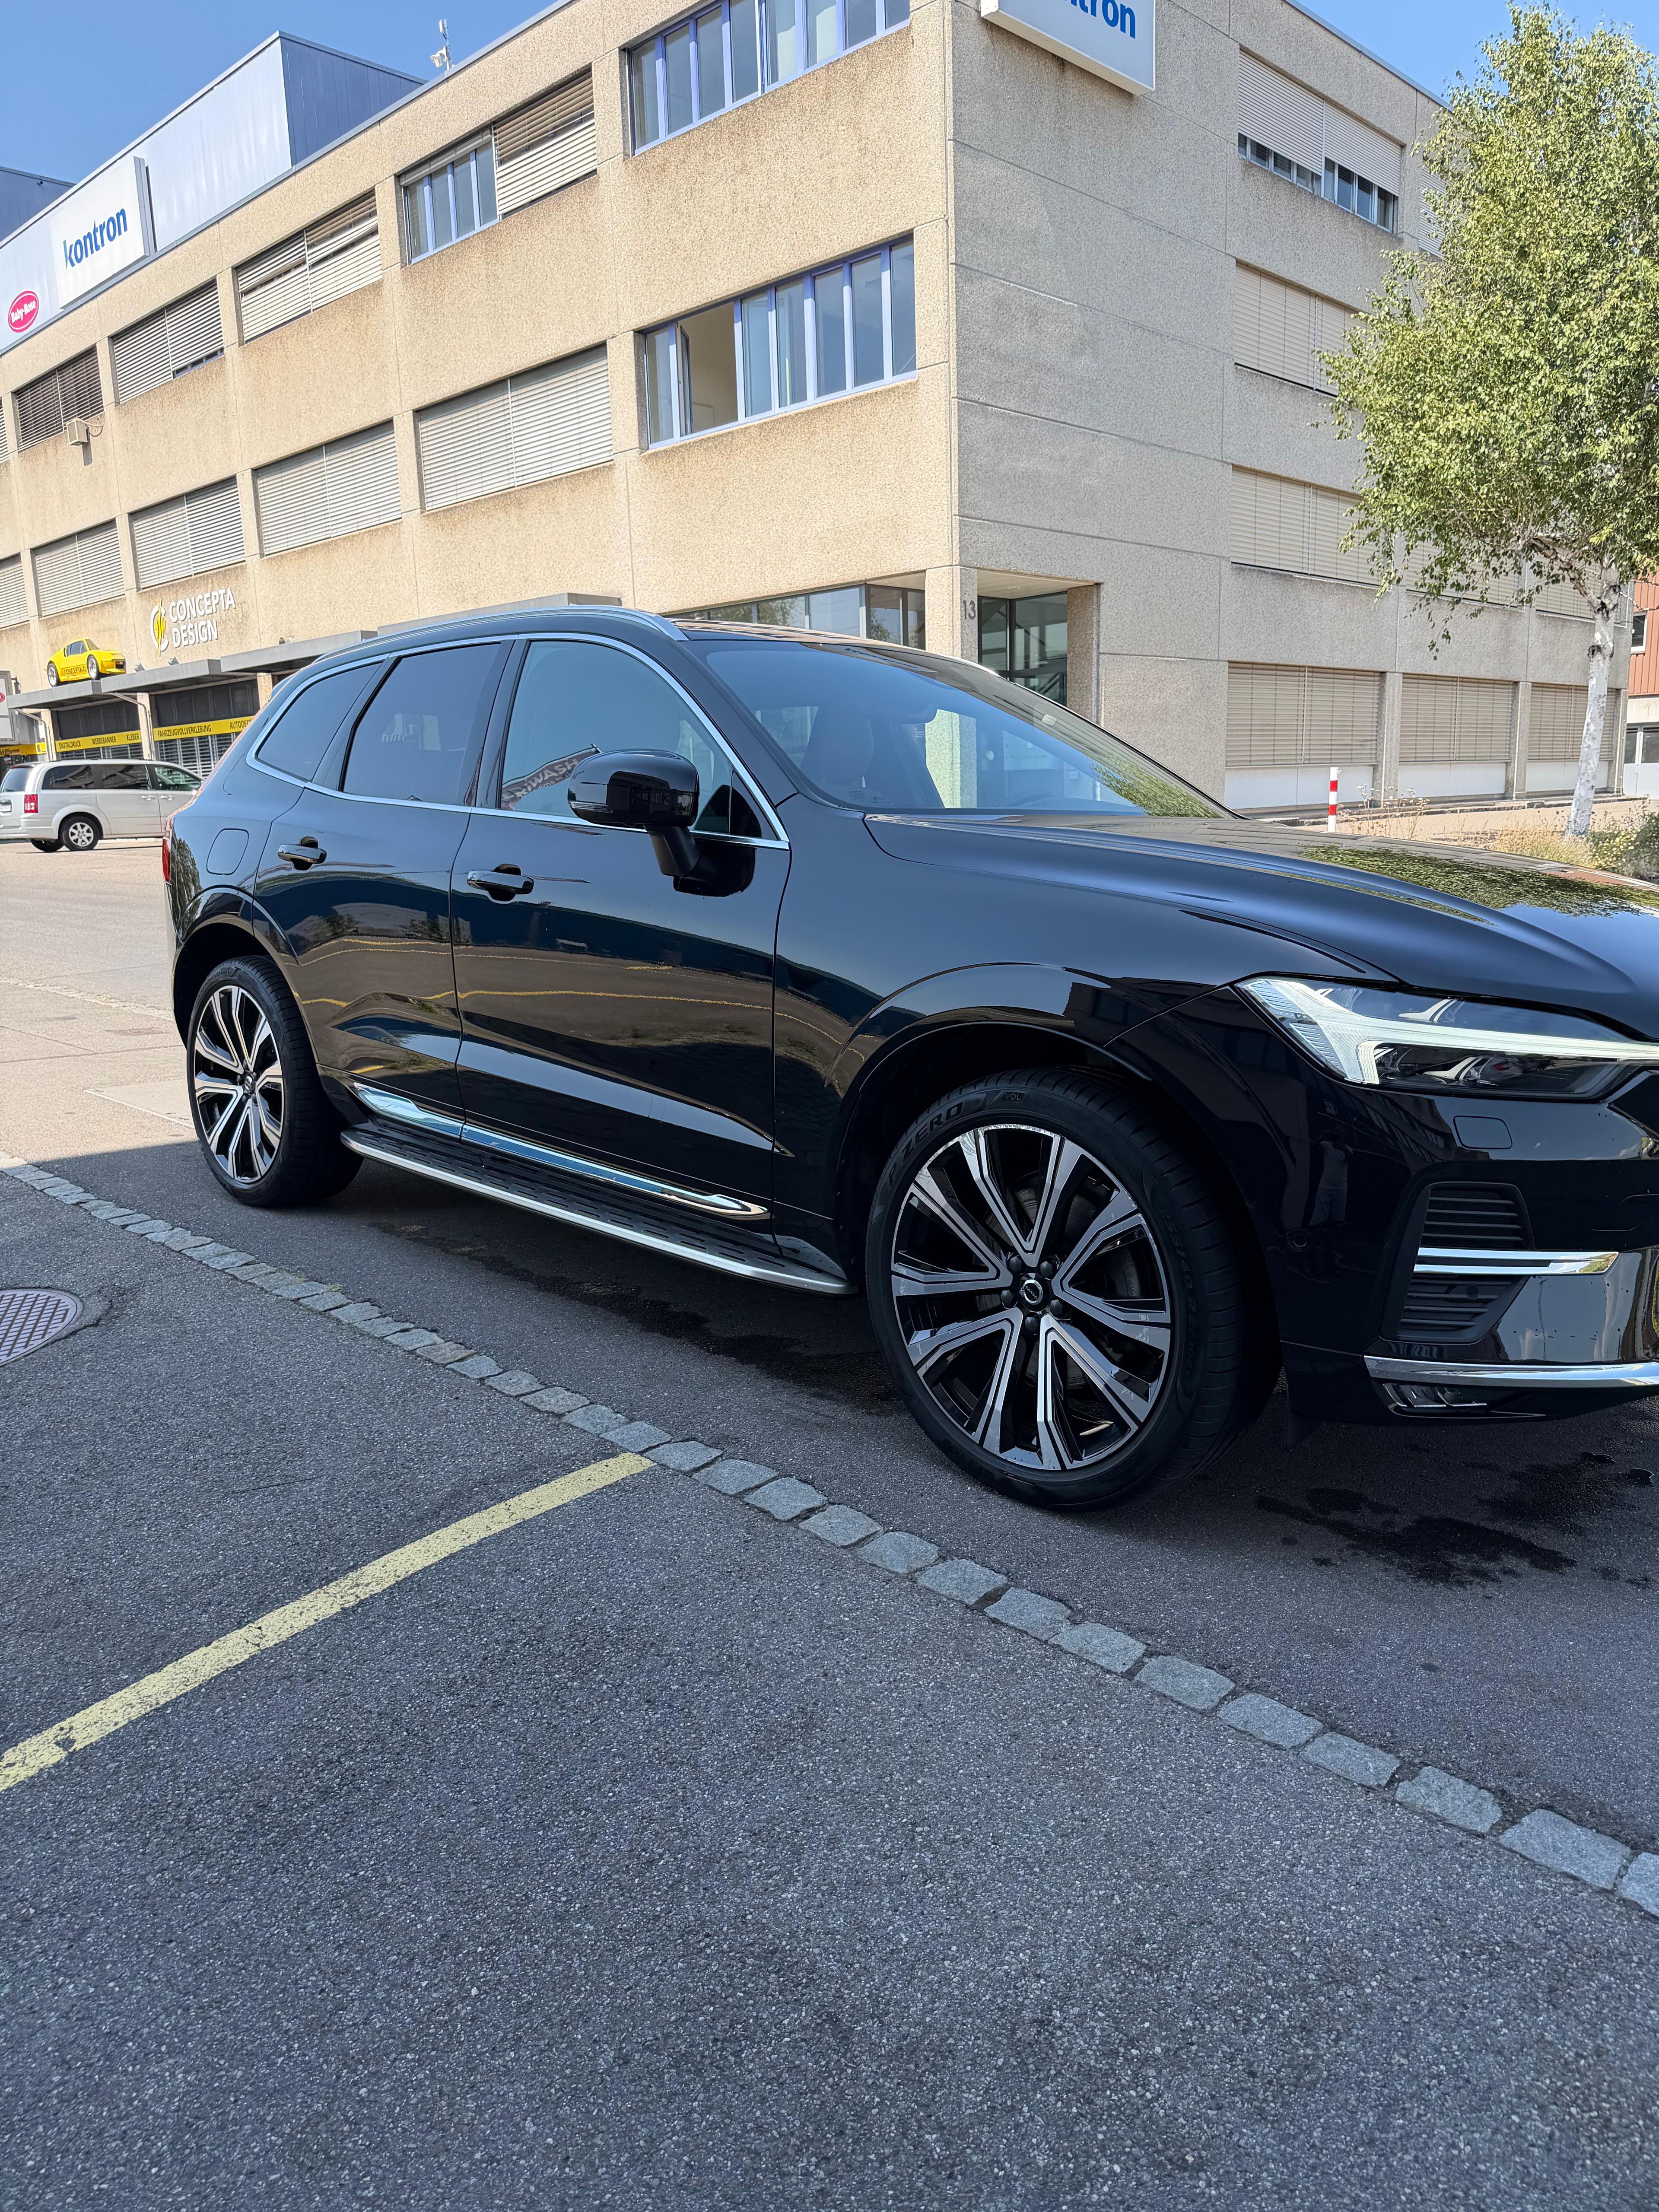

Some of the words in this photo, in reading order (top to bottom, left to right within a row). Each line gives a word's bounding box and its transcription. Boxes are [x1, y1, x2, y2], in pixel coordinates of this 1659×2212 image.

[63, 208, 127, 270] kontron
[11, 300, 36, 323] Baby-Rose
[169, 587, 236, 623] CONCEPTA
[963, 600, 976, 620] 13
[172, 618, 219, 648] DESIGN
[158, 724, 212, 737] FAHRZEUGVOLLVERKLEBUNG
[59, 740, 81, 750] DIGITALDRUCK
[92, 736, 117, 745] WERBEBANNER
[126, 733, 140, 741] KLEBER
[1005, 1092, 1021, 1101] VOL
[902, 1101, 964, 1163] ZERO
[1024, 1285, 1038, 1300] VOLVO
